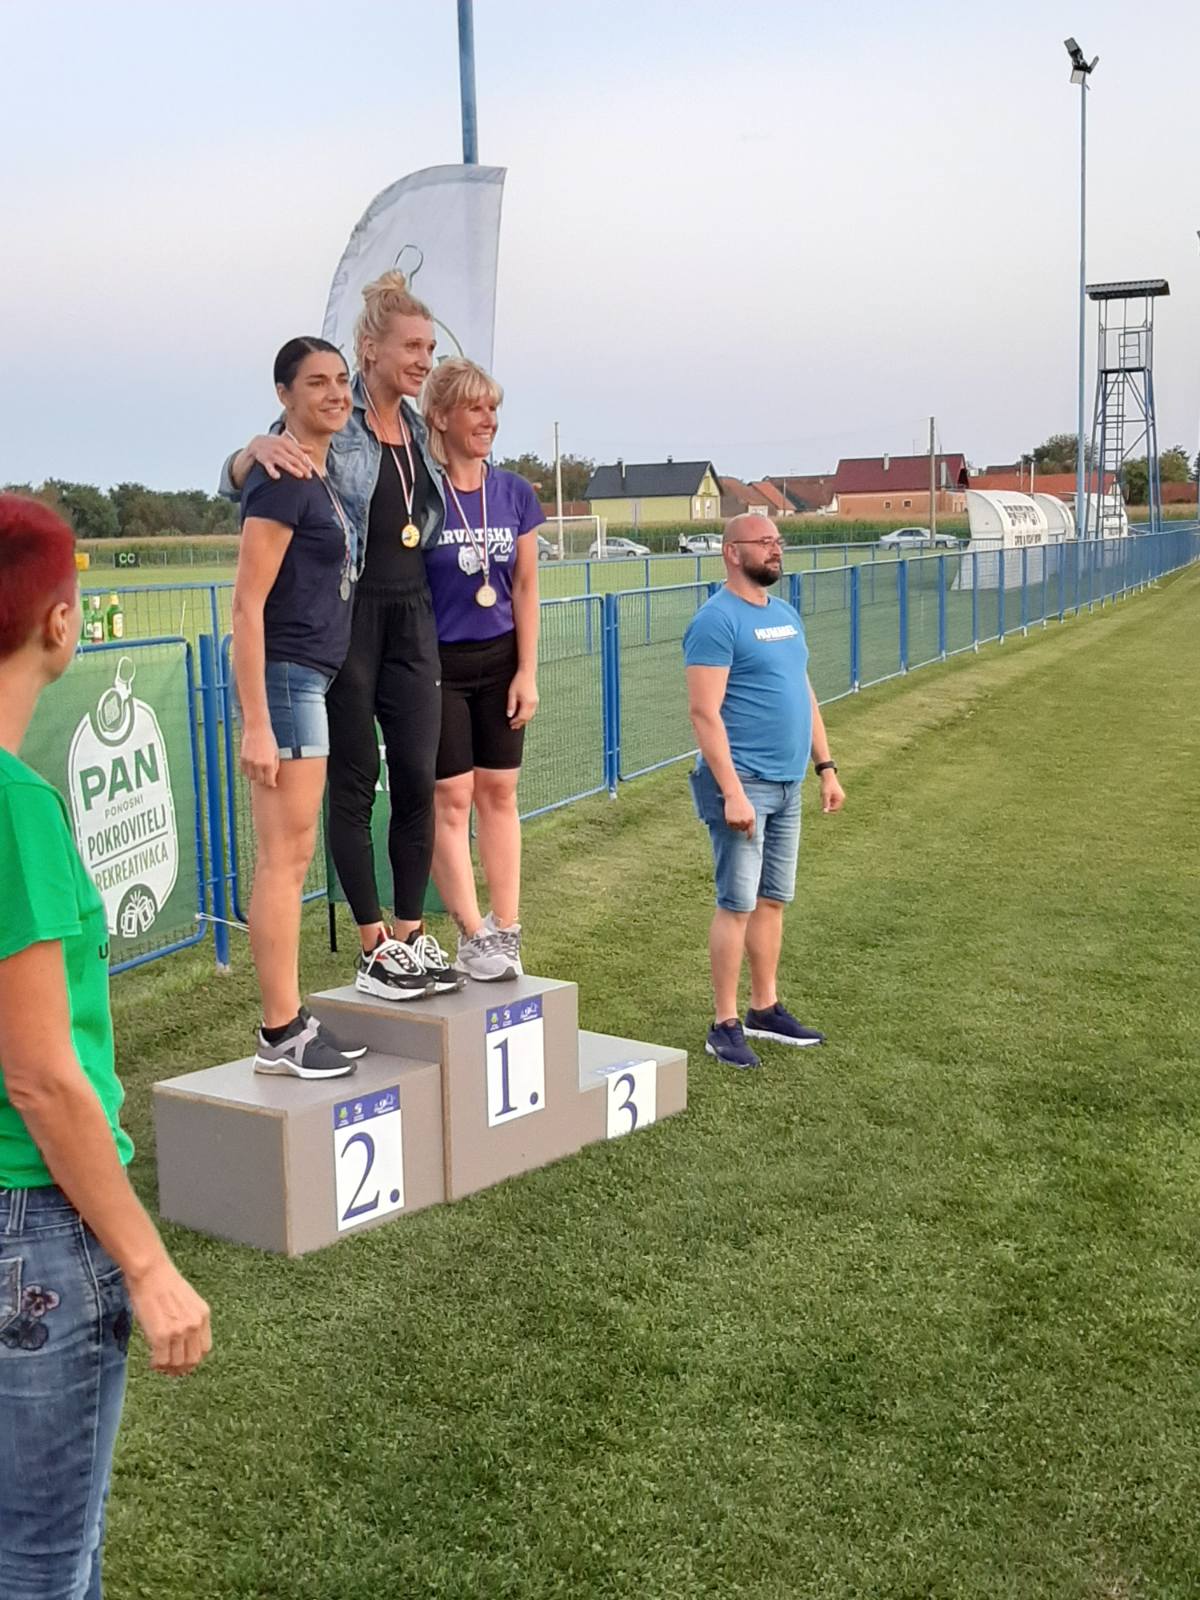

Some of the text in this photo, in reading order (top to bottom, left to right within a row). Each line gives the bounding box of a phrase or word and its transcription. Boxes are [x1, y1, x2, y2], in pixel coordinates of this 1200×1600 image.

[437, 527, 514, 546] RVATSKA
[79, 742, 160, 812] PAN
[87, 803, 167, 861] POKROVITELJ
[104, 794, 144, 819] PONOSNI
[94, 841, 169, 892] REKREATIVACA
[493, 1037, 539, 1117] 1.
[341, 1131, 400, 1221] 2.
